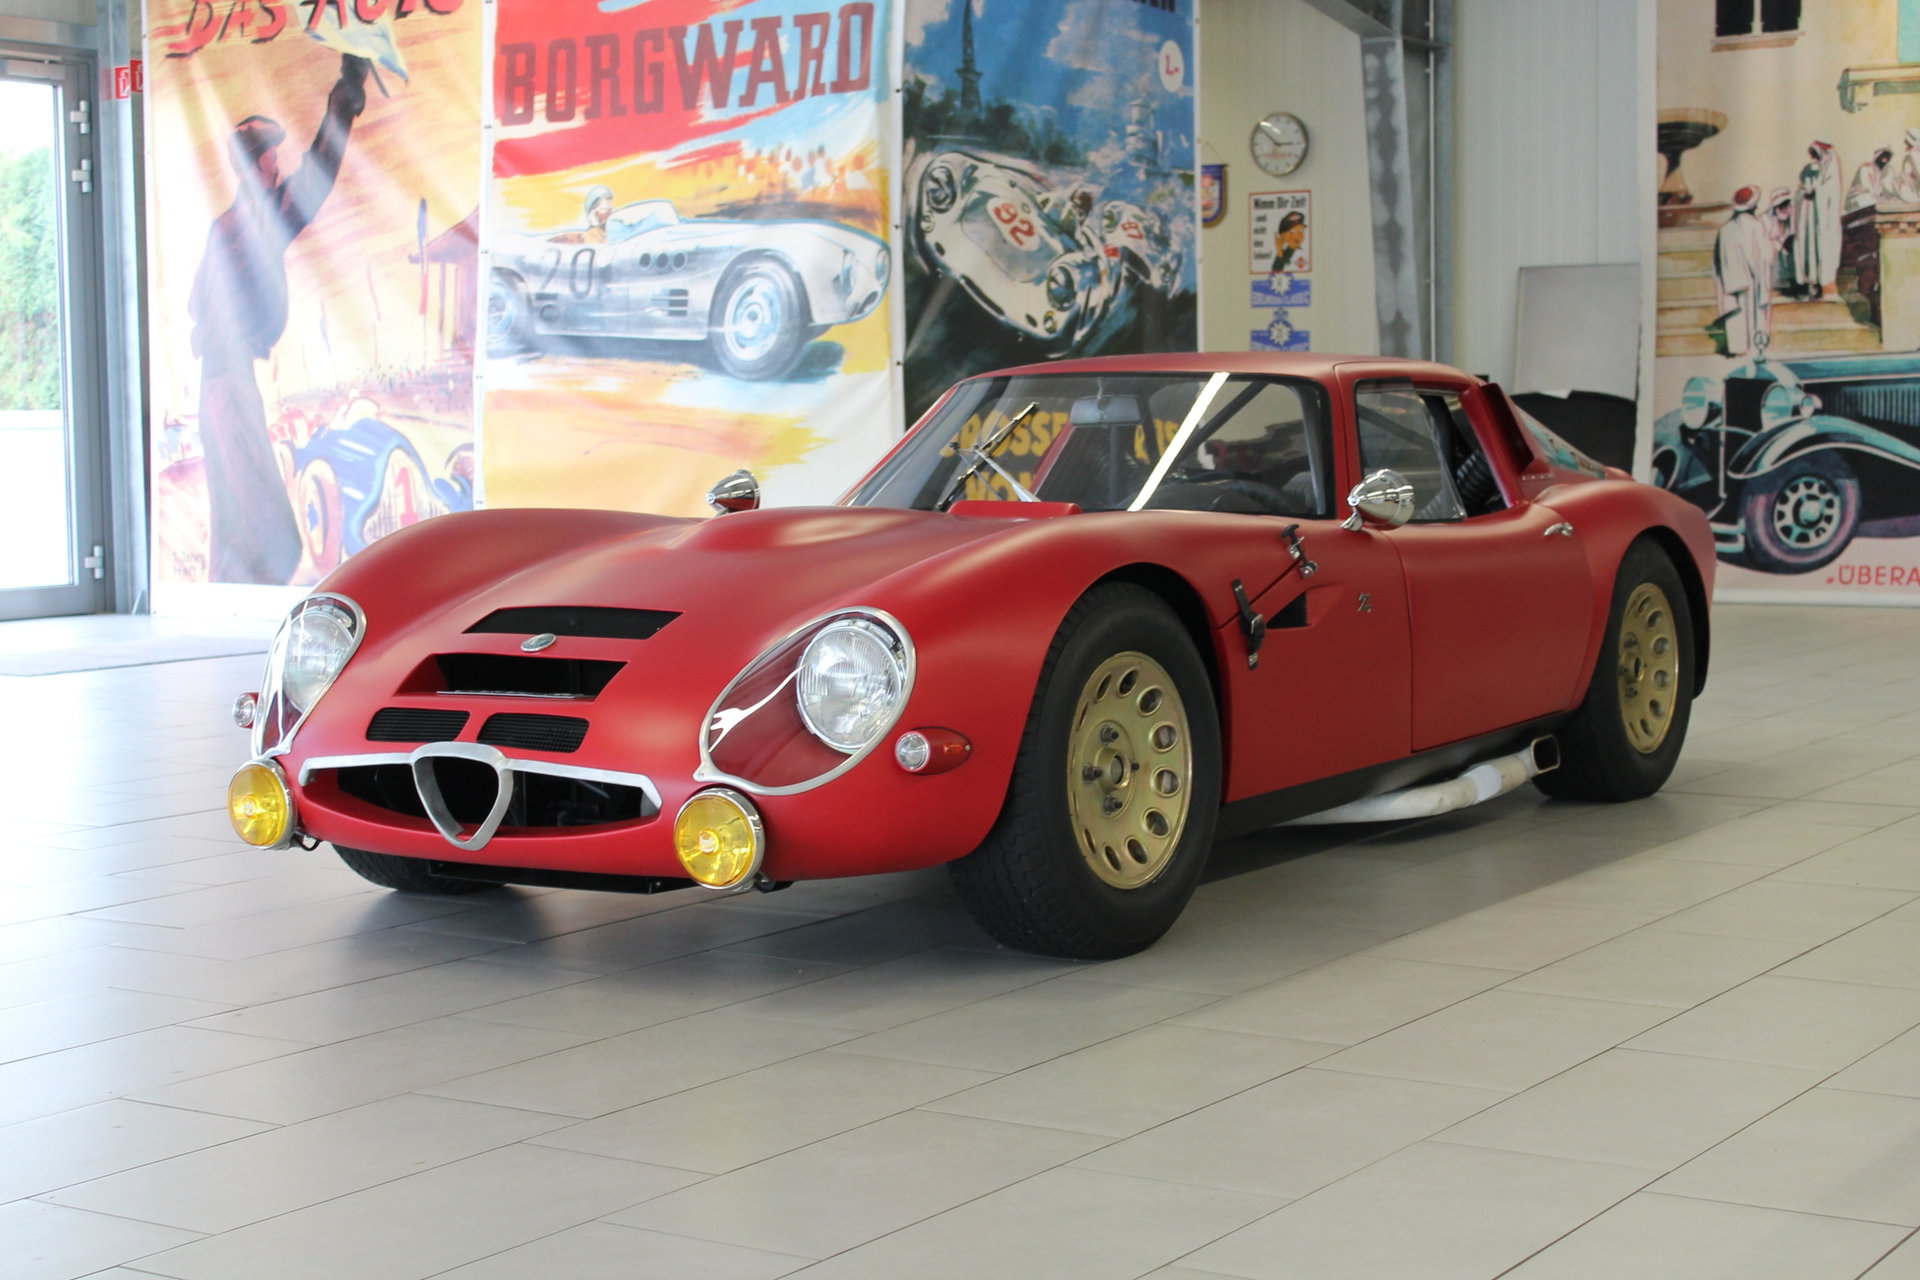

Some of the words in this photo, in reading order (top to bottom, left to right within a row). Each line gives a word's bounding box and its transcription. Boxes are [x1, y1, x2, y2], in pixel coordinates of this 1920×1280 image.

[501, 2, 875, 126] BORGWARD
[993, 202, 1036, 246] 92
[534, 247, 596, 300] 20
